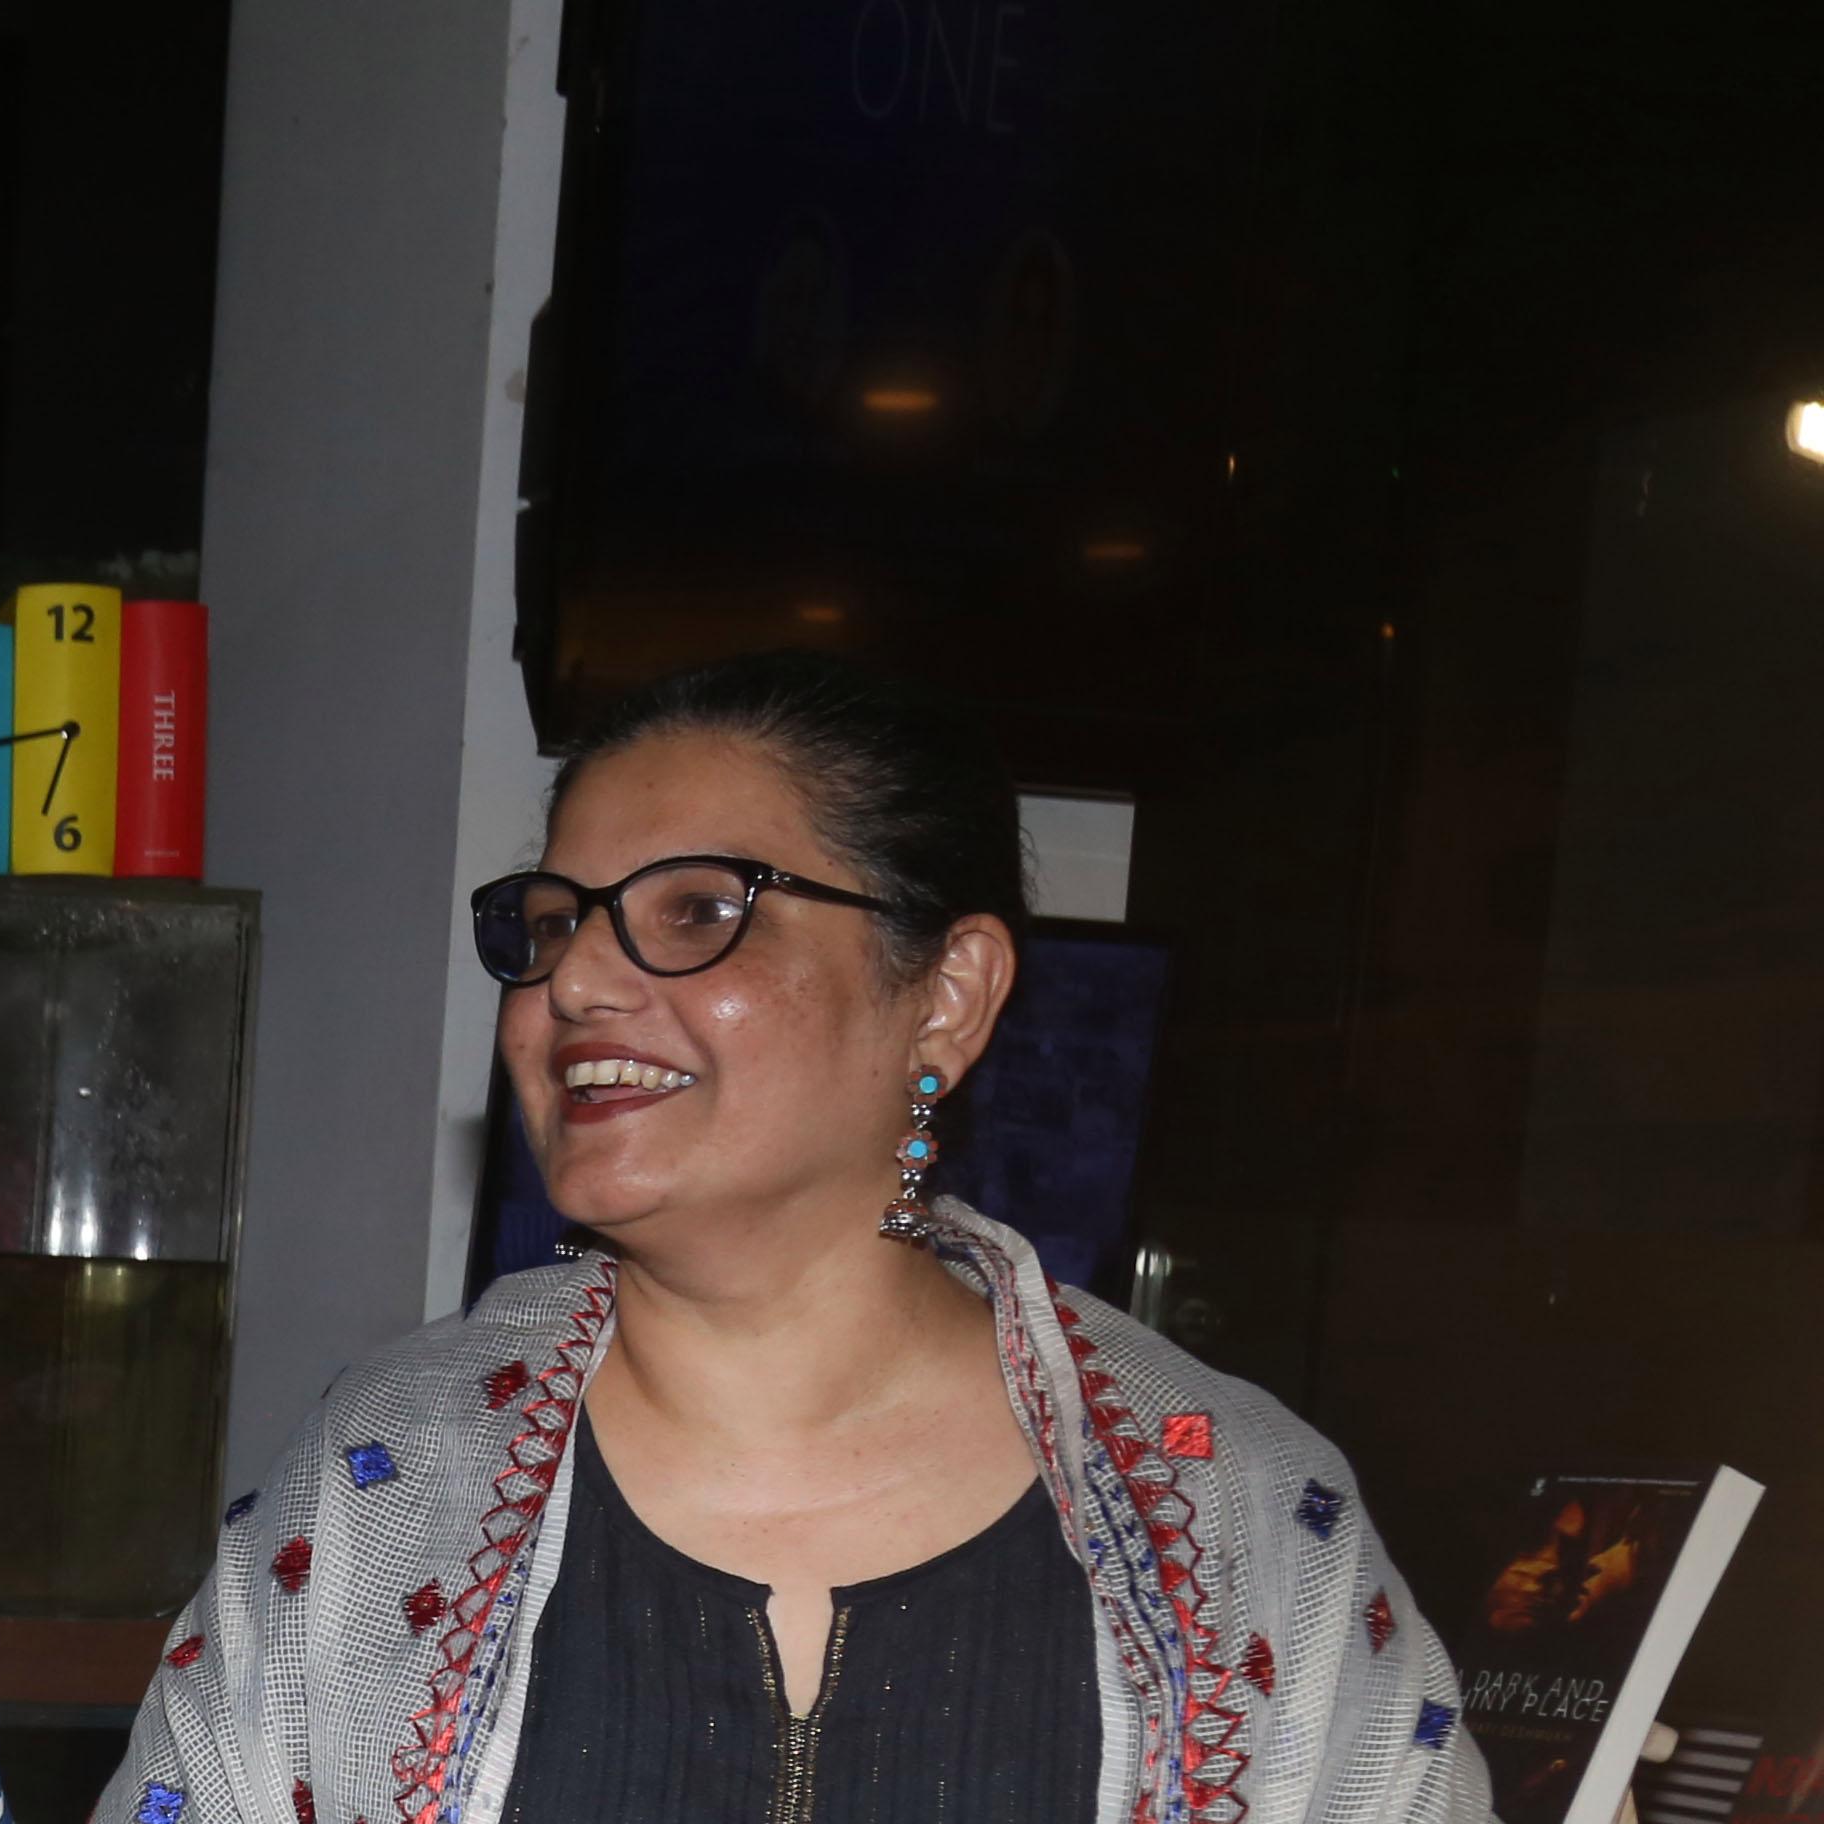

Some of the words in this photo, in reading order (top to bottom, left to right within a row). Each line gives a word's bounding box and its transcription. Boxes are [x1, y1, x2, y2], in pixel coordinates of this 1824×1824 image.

[47, 604, 95, 642] 12
[152, 690, 175, 781] THREE
[54, 815, 82, 852] 6
[1473, 1670, 1540, 1695] DARK
[1549, 1676, 1605, 1702] AND
[1521, 1692, 1609, 1722] PLACE
